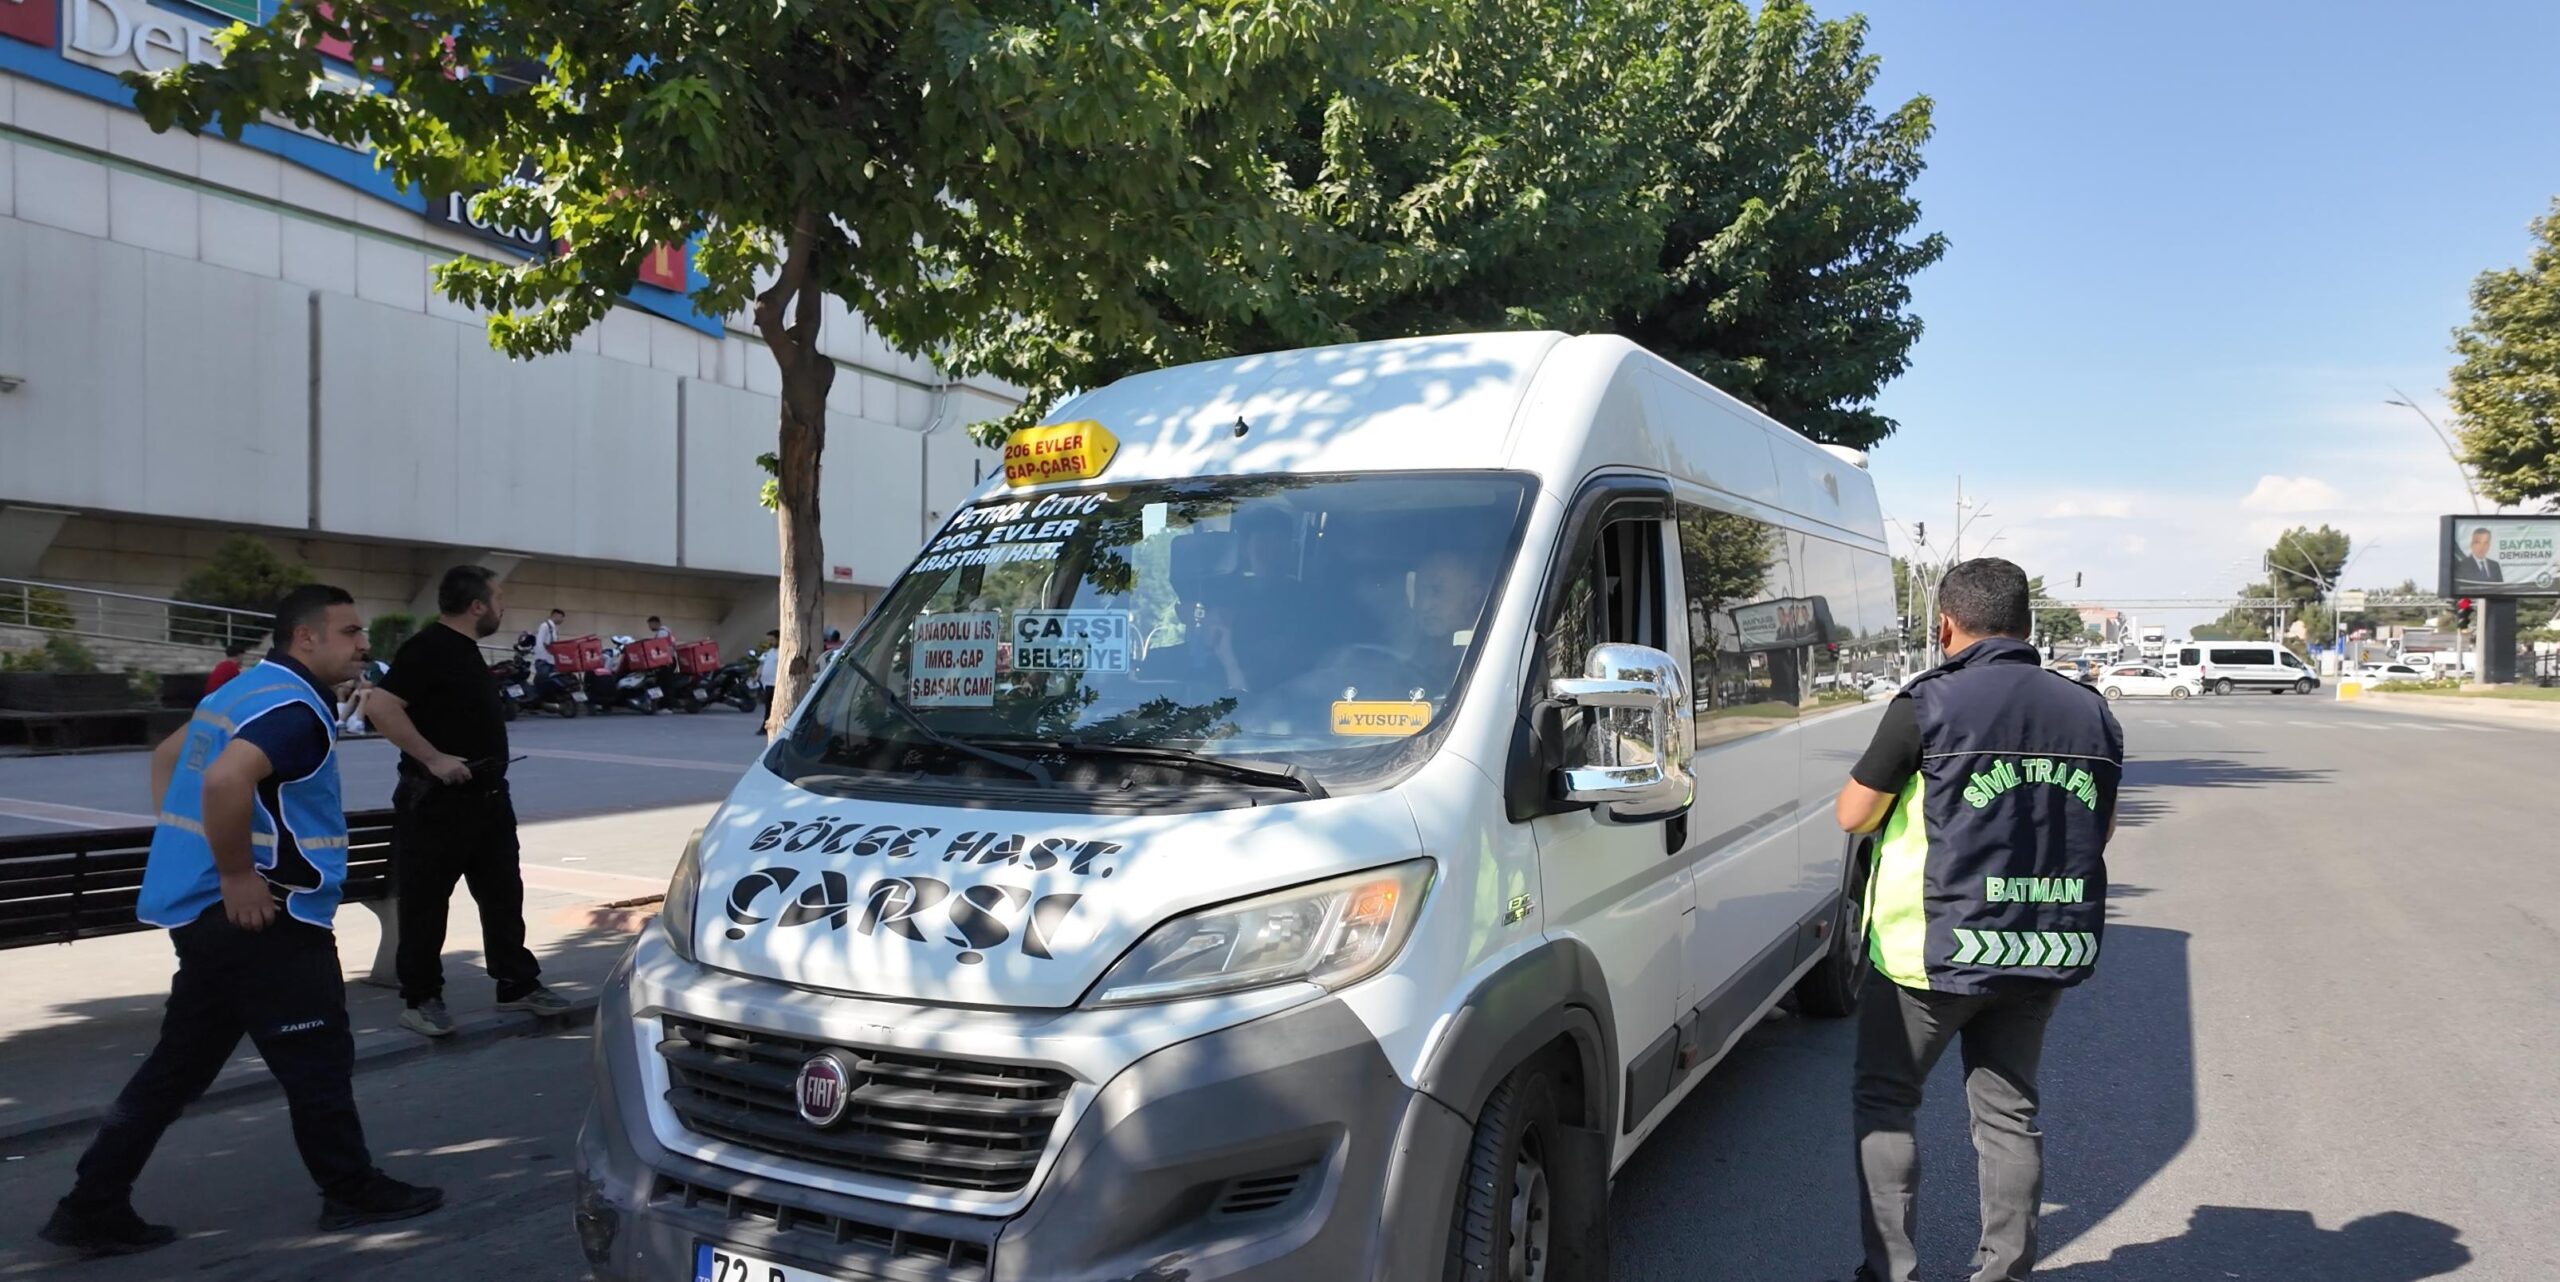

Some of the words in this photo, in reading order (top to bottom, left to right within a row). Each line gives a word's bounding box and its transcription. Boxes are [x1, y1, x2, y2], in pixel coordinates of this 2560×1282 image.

[1004, 444, 1030, 460] 206
[1035, 435, 1084, 455] EVLER
[1005, 455, 1088, 479] GAP-ÇARŞI
[946, 501, 1030, 532] PETROL
[929, 530, 982, 553] 206
[983, 519, 1081, 545] EVLER
[2499, 539, 2552, 550] BAYRAM
[917, 621, 971, 642] ANADOLU
[1018, 618, 1124, 644] ÇARŞI
[1018, 645, 1122, 668] BELEDİYE
[1353, 714, 1409, 726] YUSUF
[749, 815, 942, 859] BÖLGE
[942, 830, 1123, 878] HAST.
[1986, 877, 2084, 903] BATMAN
[725, 867, 1083, 965] ÇARŞI
[281, 1020, 325, 1032] ZABITA
[806, 1076, 836, 1108] FIAT
